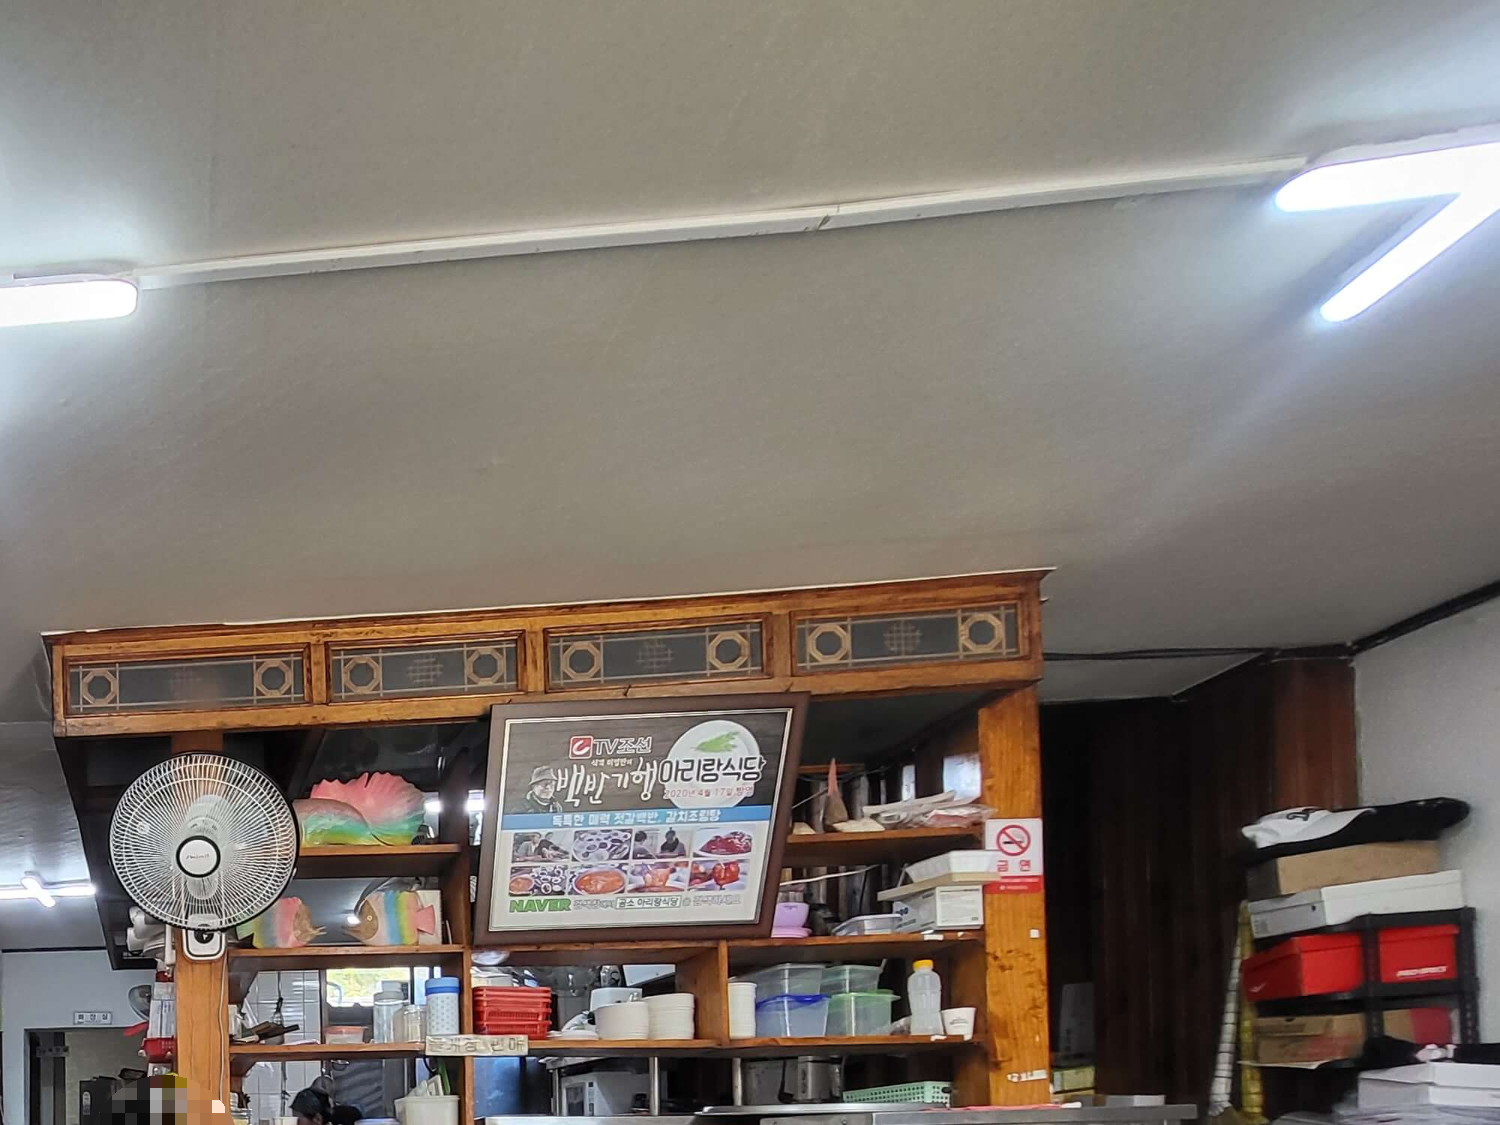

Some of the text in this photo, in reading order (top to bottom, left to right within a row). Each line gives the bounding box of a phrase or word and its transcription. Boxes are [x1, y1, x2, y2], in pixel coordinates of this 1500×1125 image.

[593, 736, 652, 755] TV조선
[659, 756, 766, 784] 아리랑식당
[664, 788, 696, 799] 2020년
[509, 898, 572, 913] NAVER
[637, 897, 679, 907] 아리랑식당
